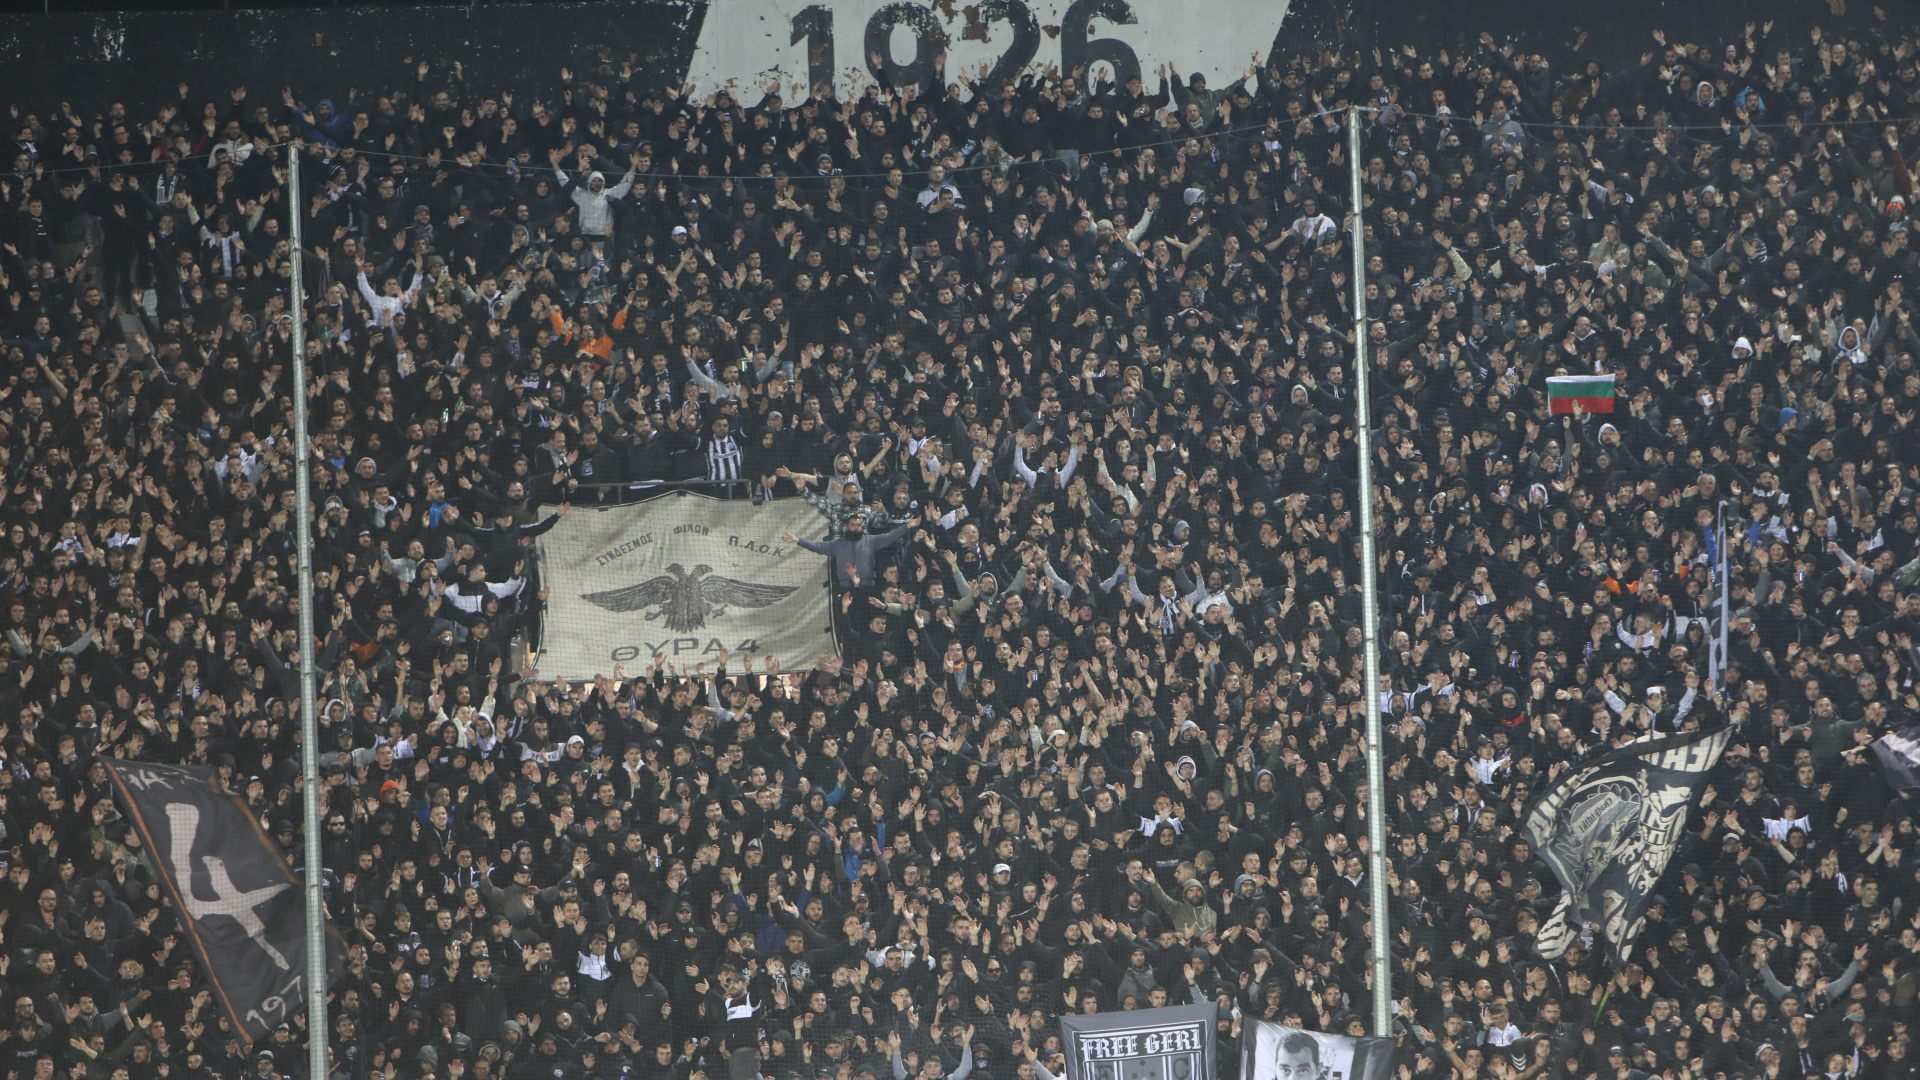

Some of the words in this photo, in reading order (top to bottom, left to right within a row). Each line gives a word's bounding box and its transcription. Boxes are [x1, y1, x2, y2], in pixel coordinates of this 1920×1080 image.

[790, 0, 1142, 103] 1926
[595, 532, 653, 566] ΣΥΝΔΕΣΜΟΣ
[673, 523, 709, 536] ΦΙΛΩΝ
[165, 803, 292, 970] 4
[246, 968, 316, 1031] 197
[1080, 1035, 1139, 1060] FREE
